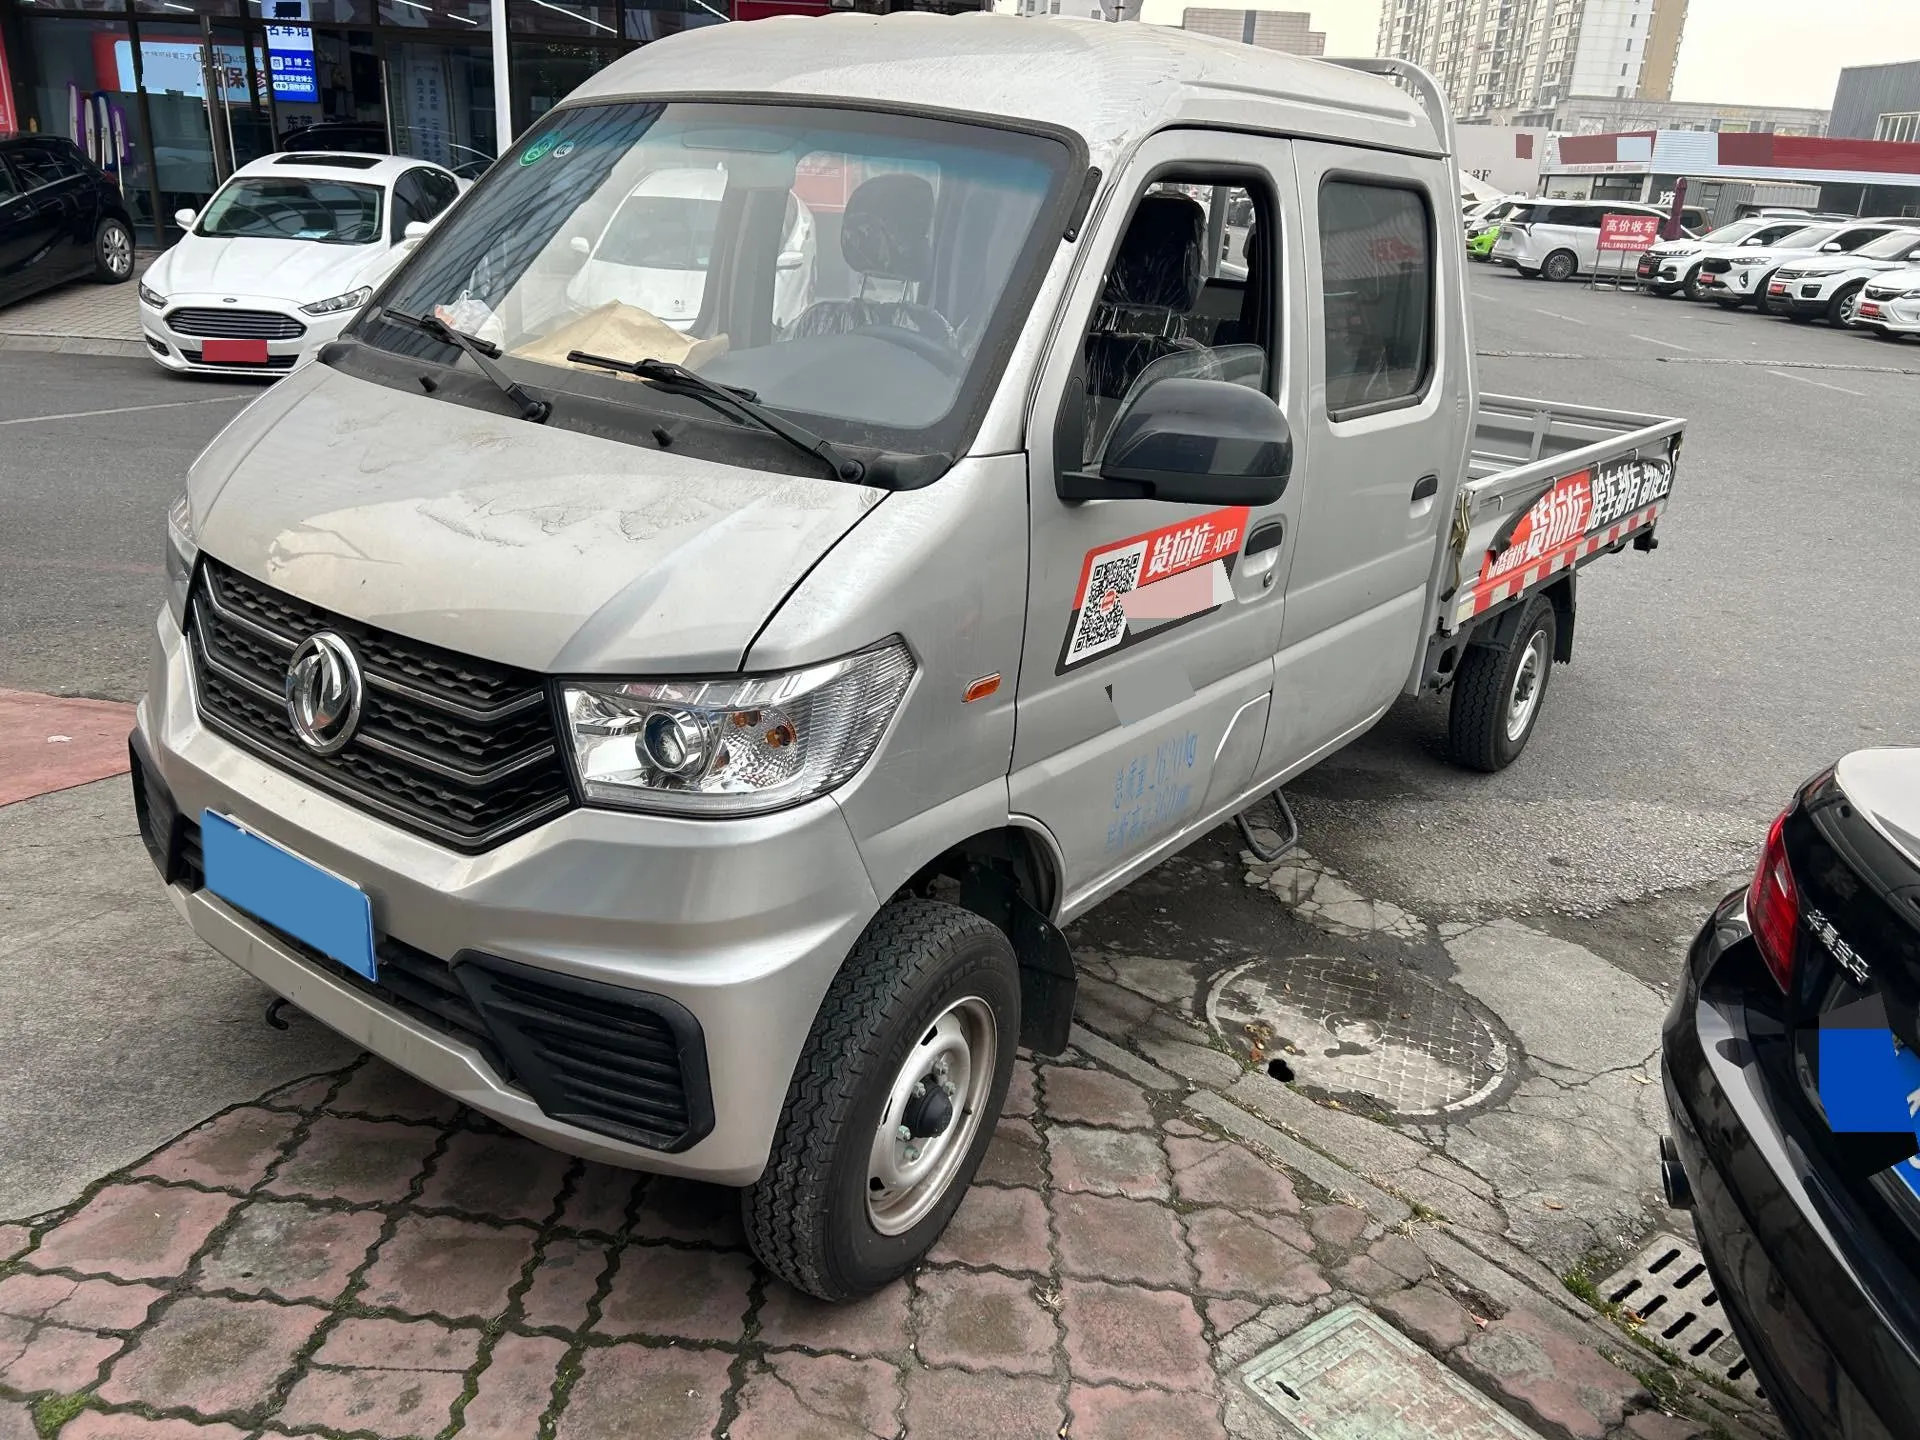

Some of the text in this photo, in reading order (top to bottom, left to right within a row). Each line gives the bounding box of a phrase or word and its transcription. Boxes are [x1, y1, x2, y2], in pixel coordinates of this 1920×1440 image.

[1606, 219, 1656, 233] 高价收车
[1146, 522, 1238, 577] 货拉拉 APP
